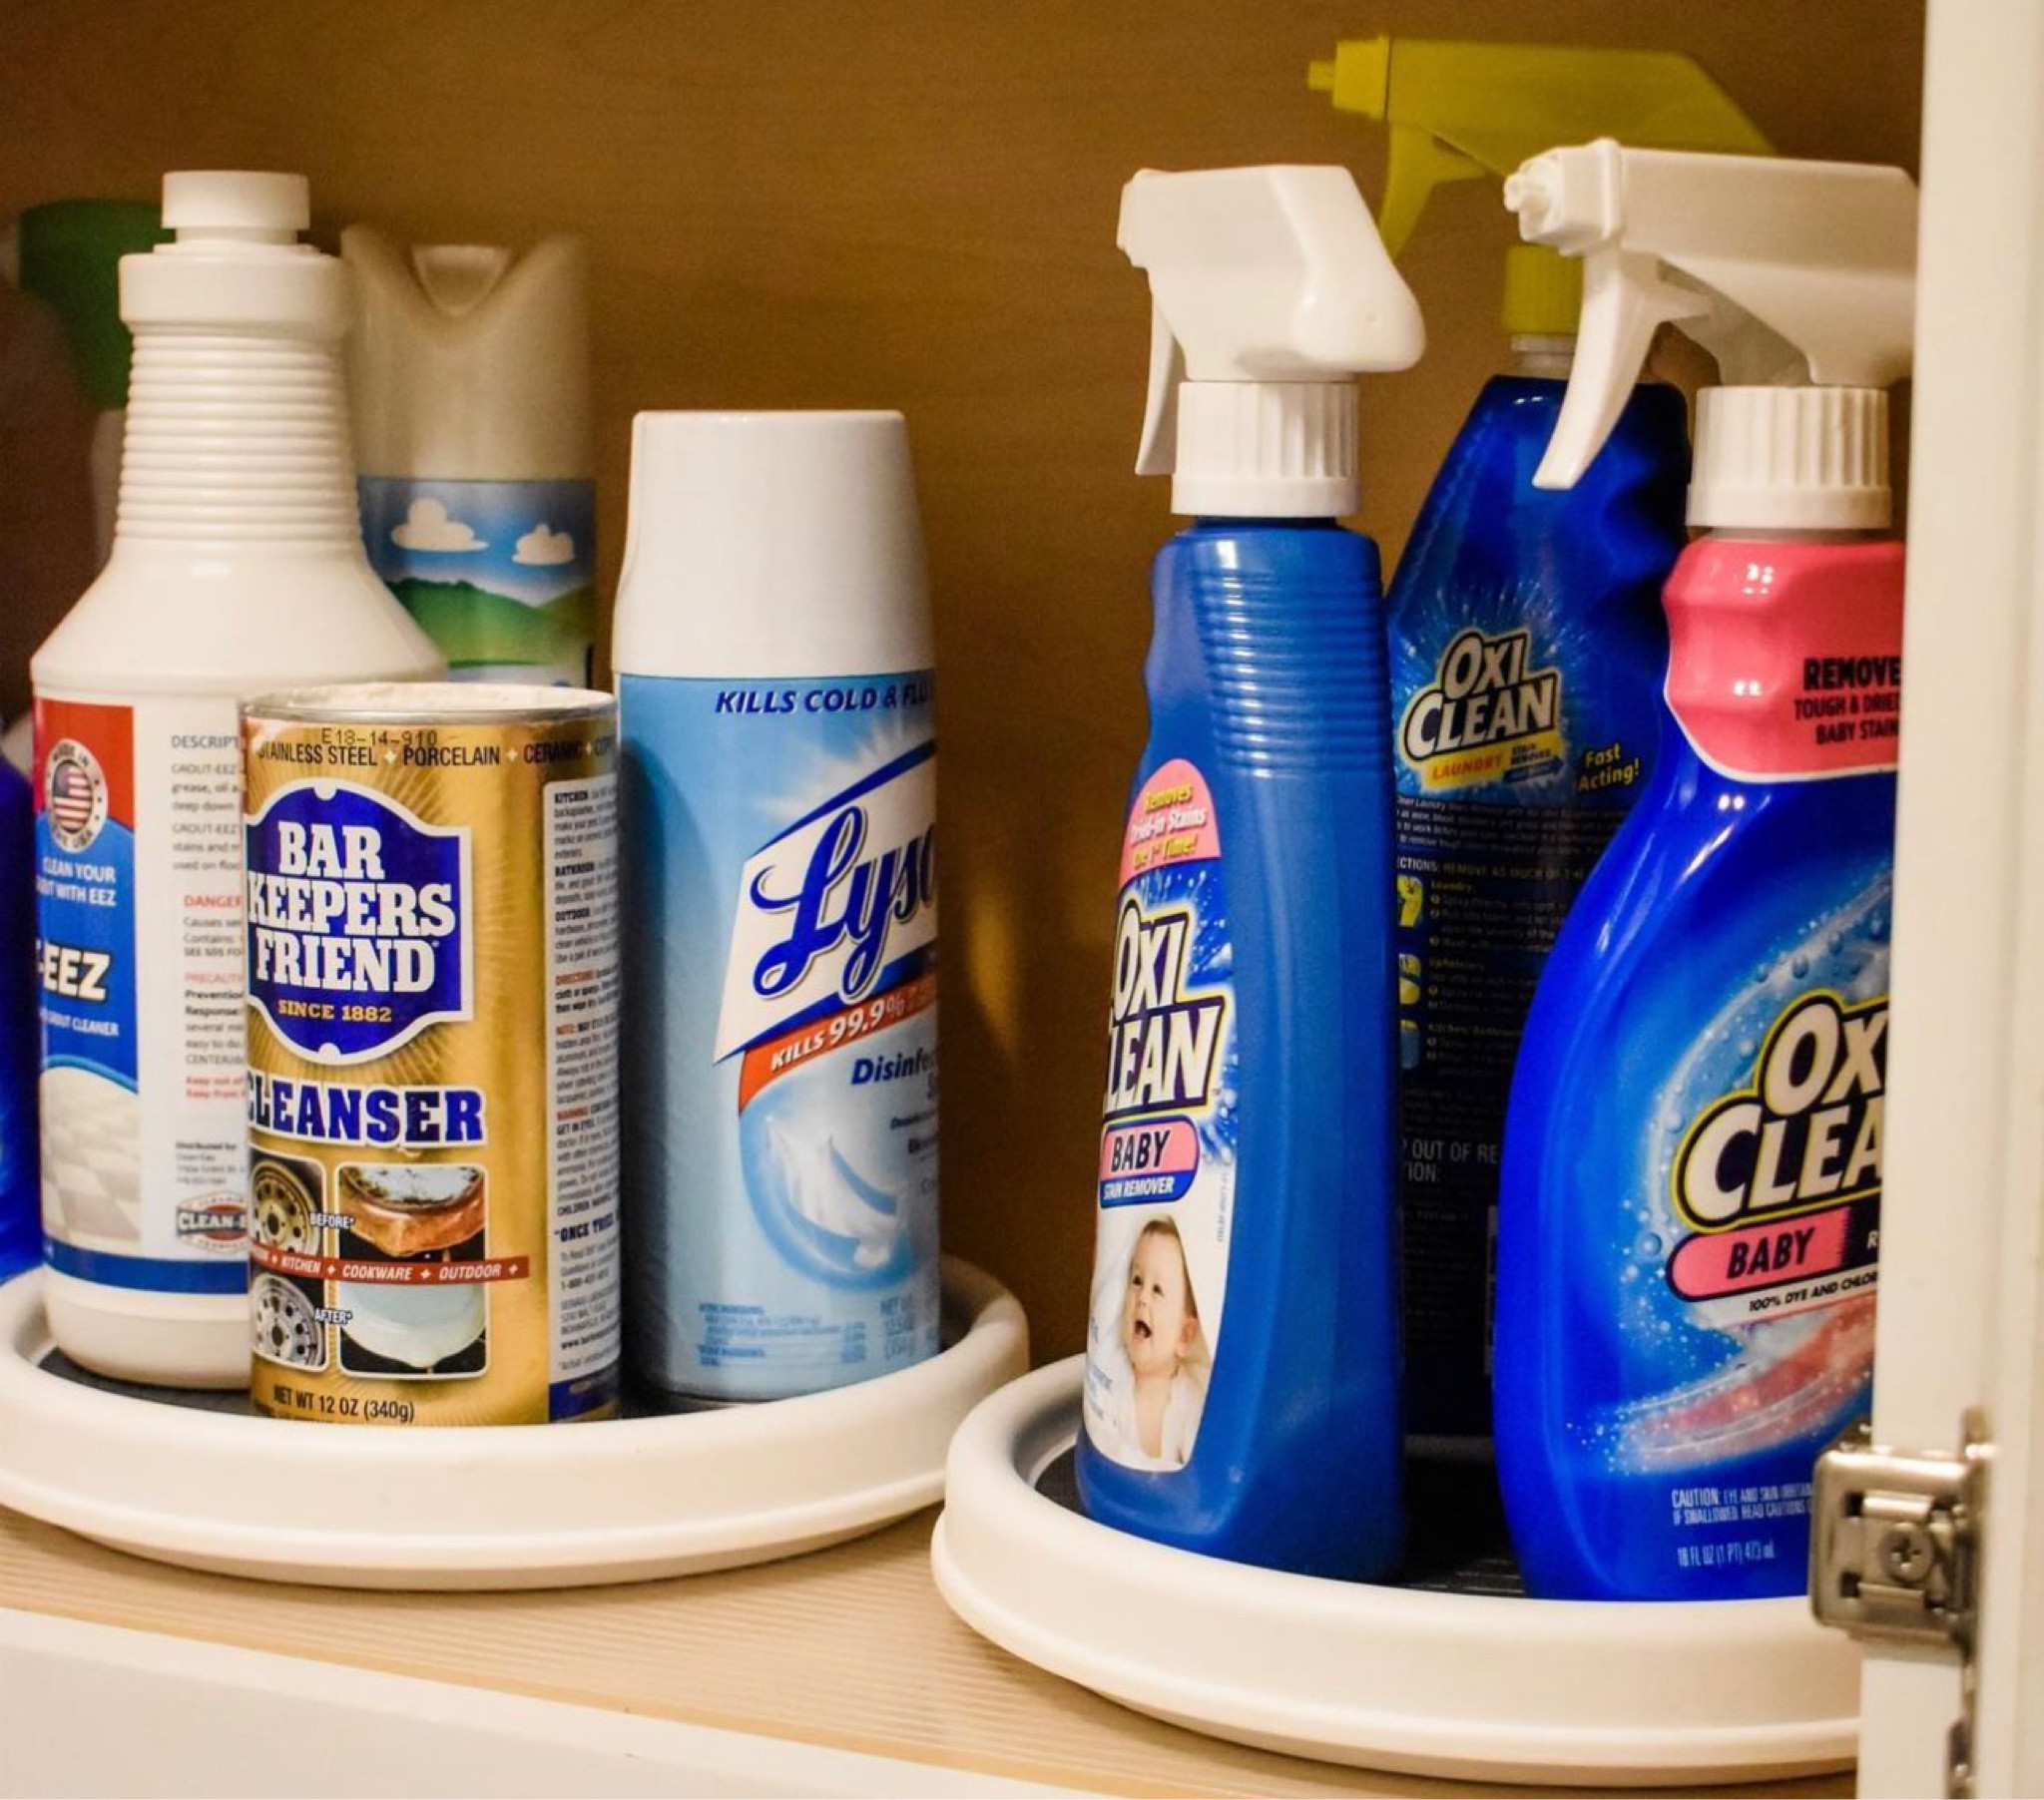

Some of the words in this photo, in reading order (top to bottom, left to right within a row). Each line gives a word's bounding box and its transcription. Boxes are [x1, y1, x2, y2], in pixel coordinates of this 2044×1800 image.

[1444, 636, 1526, 699] OXI
[1803, 656, 1901, 690] REMOVE
[715, 690, 796, 714] KILLS
[803, 686, 876, 712] COLD
[882, 684, 896, 709] &
[1793, 696, 1845, 720] TOUGH
[1406, 674, 1555, 758] CLEAN
[1815, 721, 1855, 744] BABY
[327, 745, 378, 766] STEEL
[403, 746, 500, 766] PORCELAIN
[1432, 753, 1503, 780] LAUNDRY
[1584, 743, 1621, 767] Fast
[1577, 758, 1640, 793] Acting!
[277, 821, 385, 880] BAR
[75, 863, 116, 883] YOUR
[89, 887, 117, 908] EEZ
[249, 870, 456, 938] KEEPERS
[256, 927, 436, 994] FRIEND
[1112, 903, 1189, 1022] OXI
[278, 1000, 335, 1020] SINCE
[341, 1004, 393, 1024] 1882
[770, 1029, 825, 1073] KILLS
[1110, 1129, 1171, 1173] BABY
[1412, 1137, 1445, 1161] OUT
[1450, 1140, 1474, 1164] OF
[1683, 1094, 1884, 1221] CLEA
[1125, 1175, 1176, 1195] REMOVER
[280, 1255, 321, 1273] KITCHEN
[341, 1266, 413, 1281] COOKWARE
[438, 1263, 501, 1280] OUTDOOR
[1727, 1226, 1815, 1280] BABY
[1749, 1293, 1782, 1312] 100%
[1785, 1287, 1808, 1305] DYE
[1810, 1280, 1839, 1298] AND
[273, 1385, 292, 1405] NET
[295, 1391, 314, 1410] WT
[318, 1395, 335, 1414] 12
[339, 1397, 358, 1417] OZ
[363, 1400, 414, 1424] (340g)
